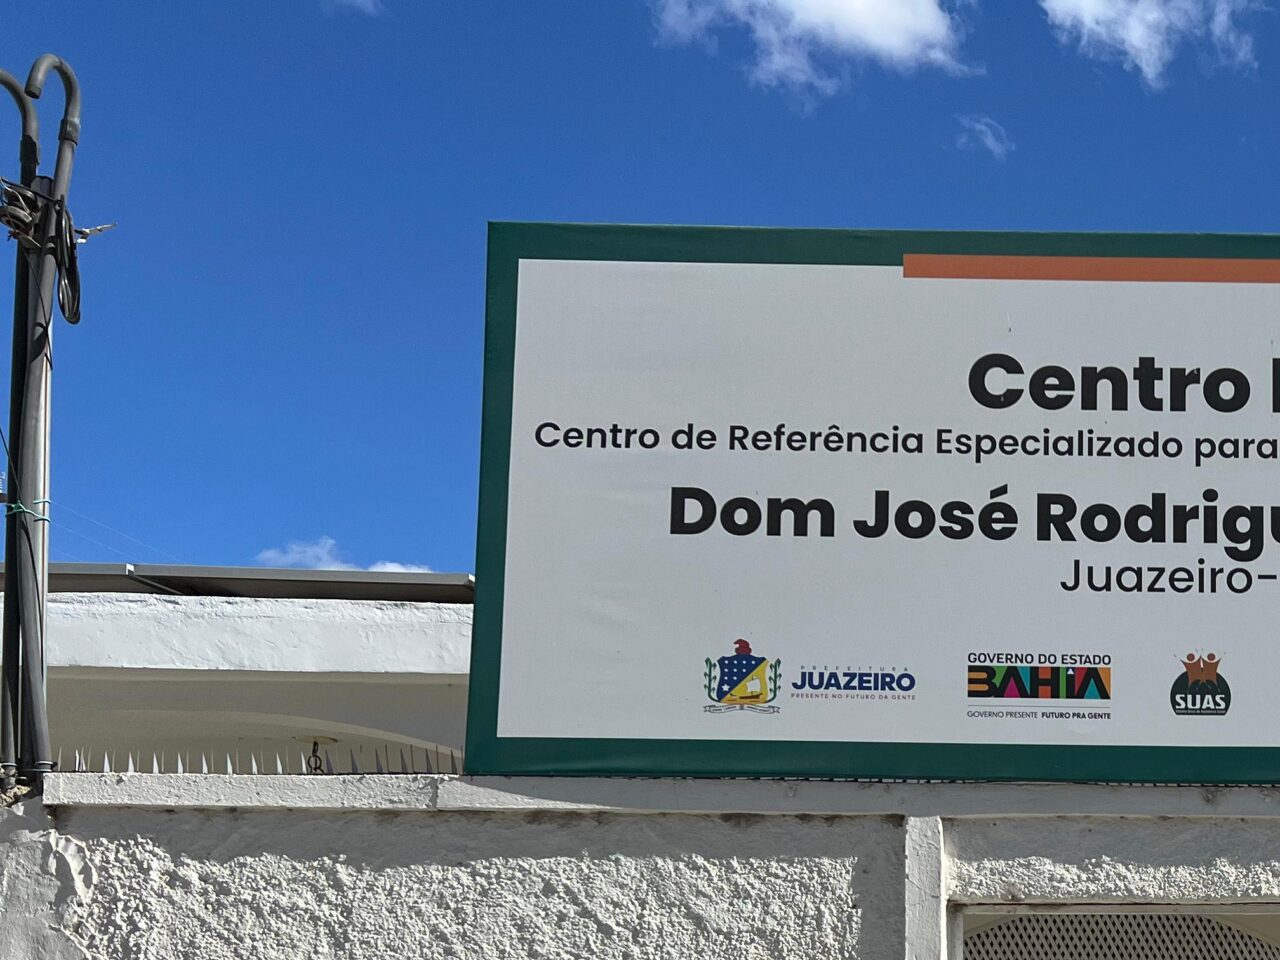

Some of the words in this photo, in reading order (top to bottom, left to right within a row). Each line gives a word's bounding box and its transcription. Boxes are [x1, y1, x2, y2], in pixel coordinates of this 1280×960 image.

[969, 354, 1251, 412] Centro
[534, 422, 660, 450] Centro
[671, 423, 717, 450] de
[729, 423, 924, 454] Referência
[936, 428, 1183, 464] Especializado
[1195, 437, 1278, 467] para
[669, 486, 835, 538] Dom
[853, 484, 1019, 541] José
[967, 652, 1034, 664] GOVERNO
[1038, 653, 1057, 665] DO
[1061, 654, 1111, 665] ESTADO
[792, 671, 916, 692] JUAZEIRO
[968, 665, 1111, 700] BAHIA
[967, 710, 1004, 718] GOVERNO
[1005, 711, 1038, 719] PRESENTE
[1041, 711, 1071, 719] FUTURO
[1087, 712, 1111, 720] GENTE
[1175, 694, 1226, 709] SUAS
